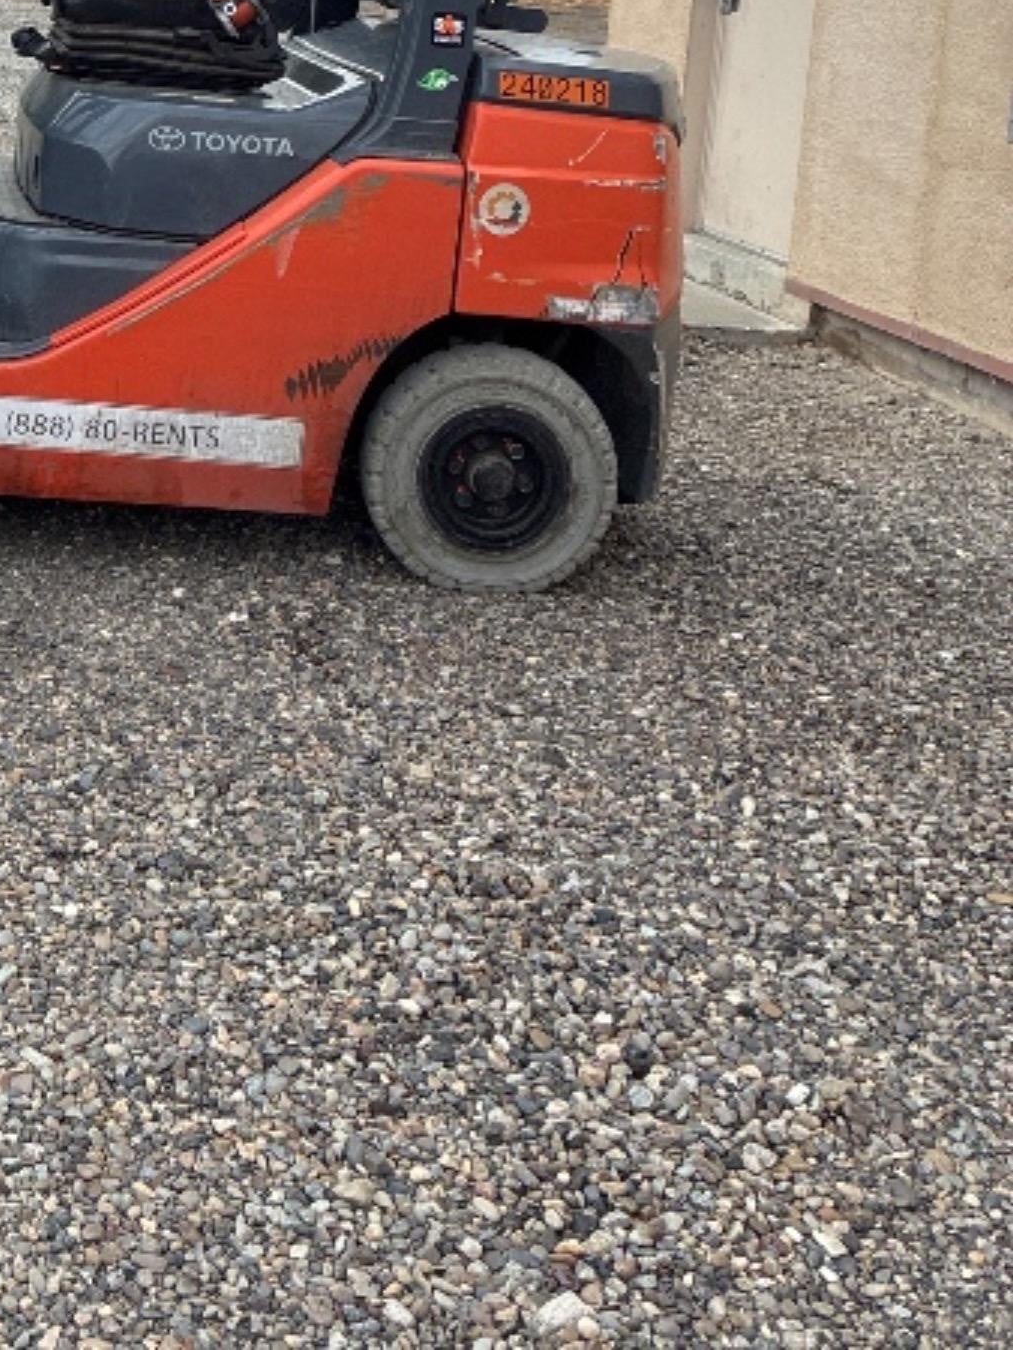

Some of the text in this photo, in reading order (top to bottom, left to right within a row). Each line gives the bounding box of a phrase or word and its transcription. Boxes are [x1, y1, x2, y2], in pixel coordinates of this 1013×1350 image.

[501, 73, 606, 105] 240218
[190, 130, 295, 158] TOYOTA
[6, 410, 75, 442] (888)
